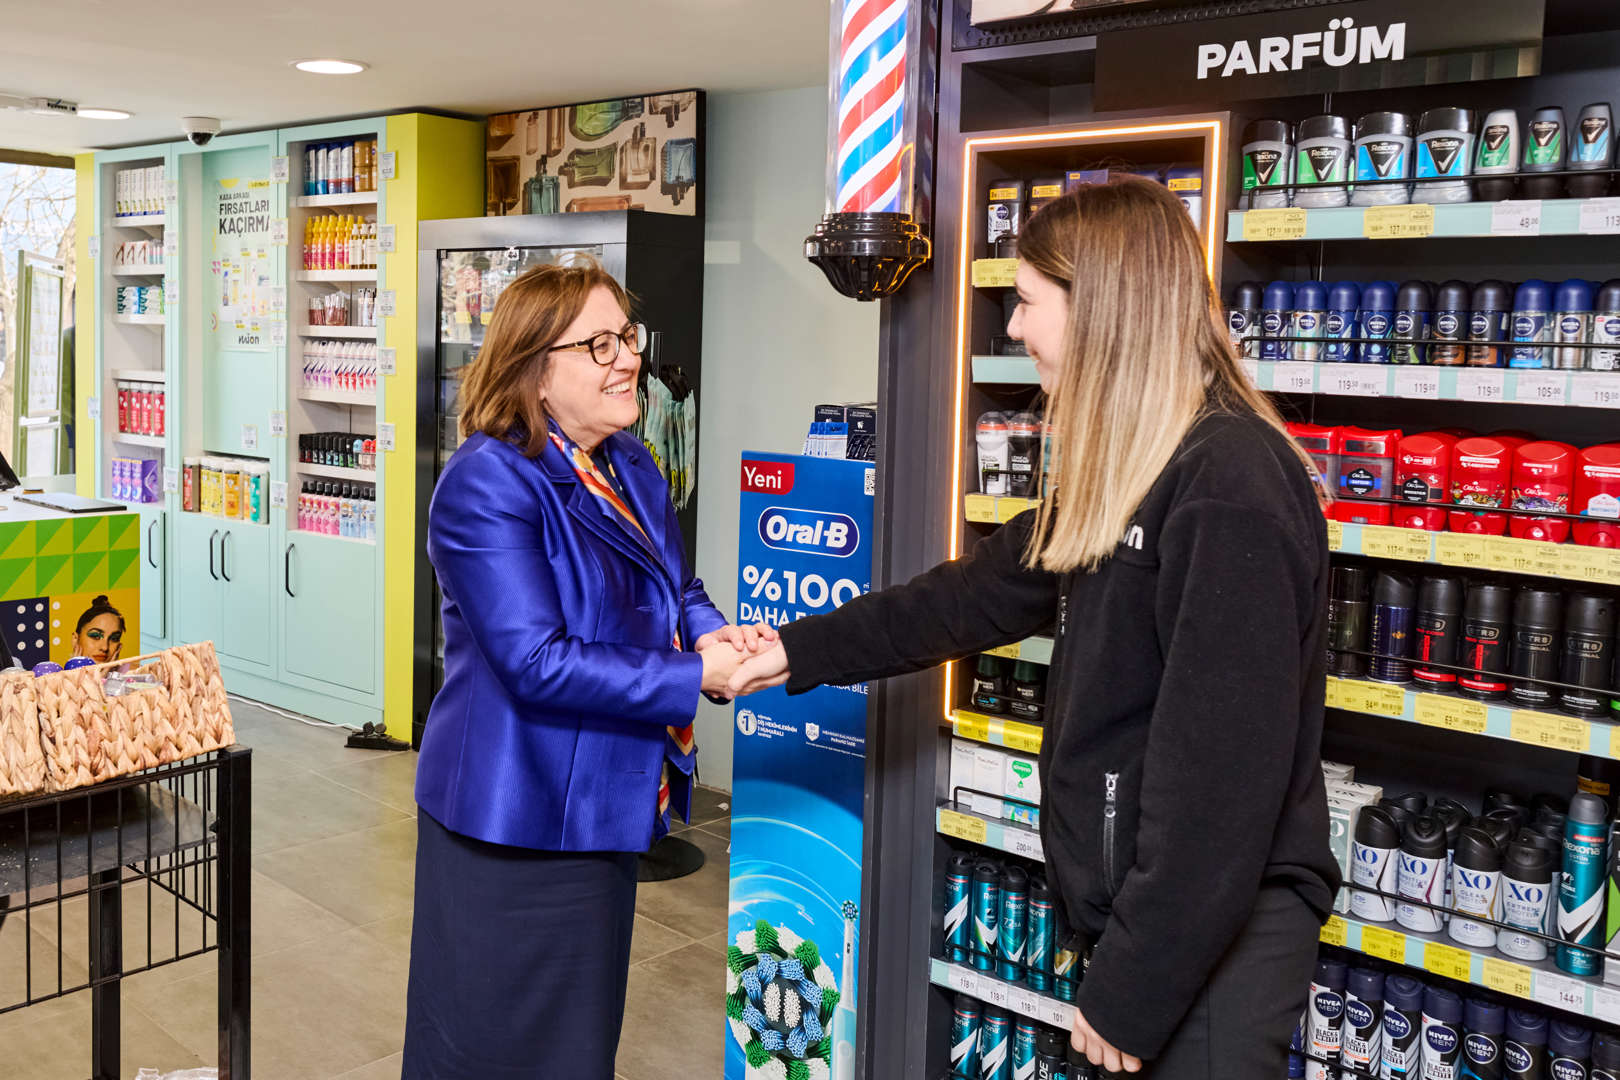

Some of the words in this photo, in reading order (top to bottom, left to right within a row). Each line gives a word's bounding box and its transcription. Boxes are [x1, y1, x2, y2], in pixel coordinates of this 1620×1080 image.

[1197, 17, 1406, 79] PARFÜM
[219, 200, 270, 216] FIRSATLARI
[743, 466, 782, 489] Yeni
[766, 515, 848, 548] Oral-B
[743, 565, 861, 608] %100
[740, 603, 788, 627] DAHA
[1458, 869, 1492, 890] XO
[1508, 882, 1543, 903] XO
[1317, 998, 1341, 1006] NIVEA
[1347, 1006, 1370, 1018] NIVEA
[1384, 1015, 1407, 1028] NIVEA
[1428, 1030, 1455, 1041] NIVEA
[1467, 1039, 1494, 1052] NIVEA
[1469, 1046, 1491, 1057] MEN
[1505, 1048, 1529, 1062] NIVEA
[1555, 1065, 1583, 1077] NIVEA
